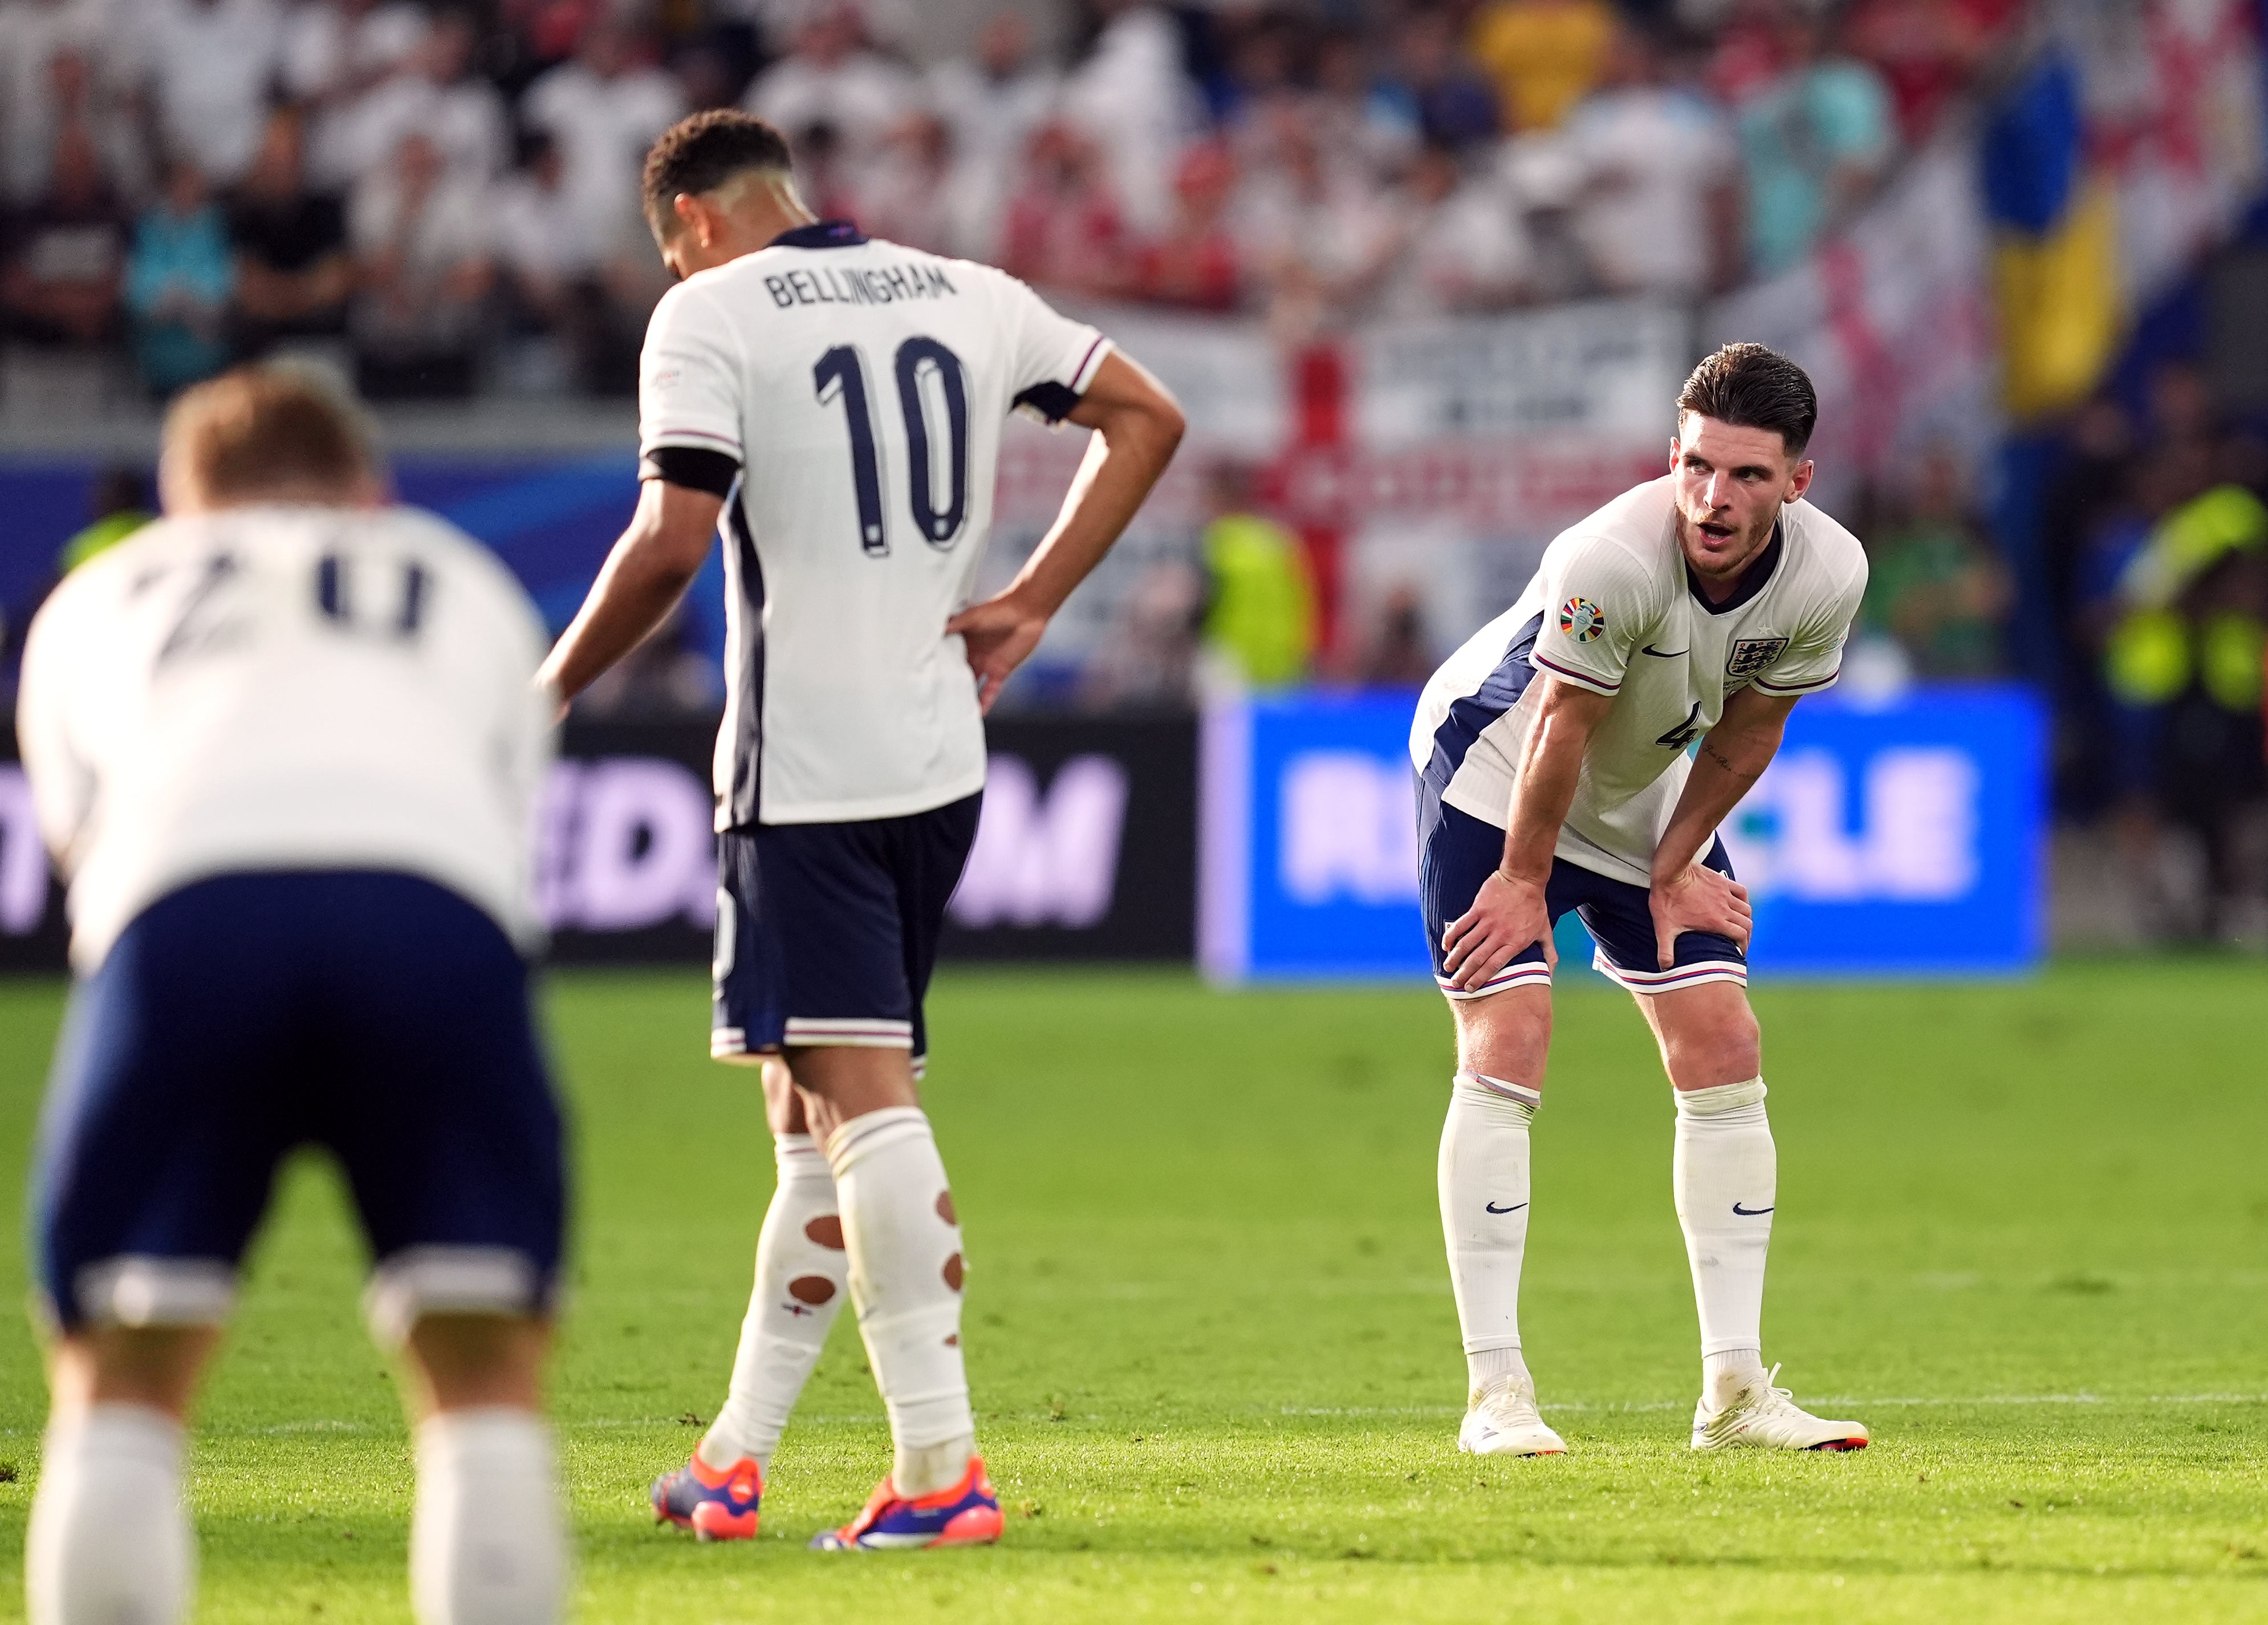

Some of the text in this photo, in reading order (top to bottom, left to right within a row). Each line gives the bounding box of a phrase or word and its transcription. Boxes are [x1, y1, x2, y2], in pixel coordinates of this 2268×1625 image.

[763, 265, 958, 309] BELLINGHAM
[813, 334, 973, 556] 10
[1655, 700, 1702, 750] 4
